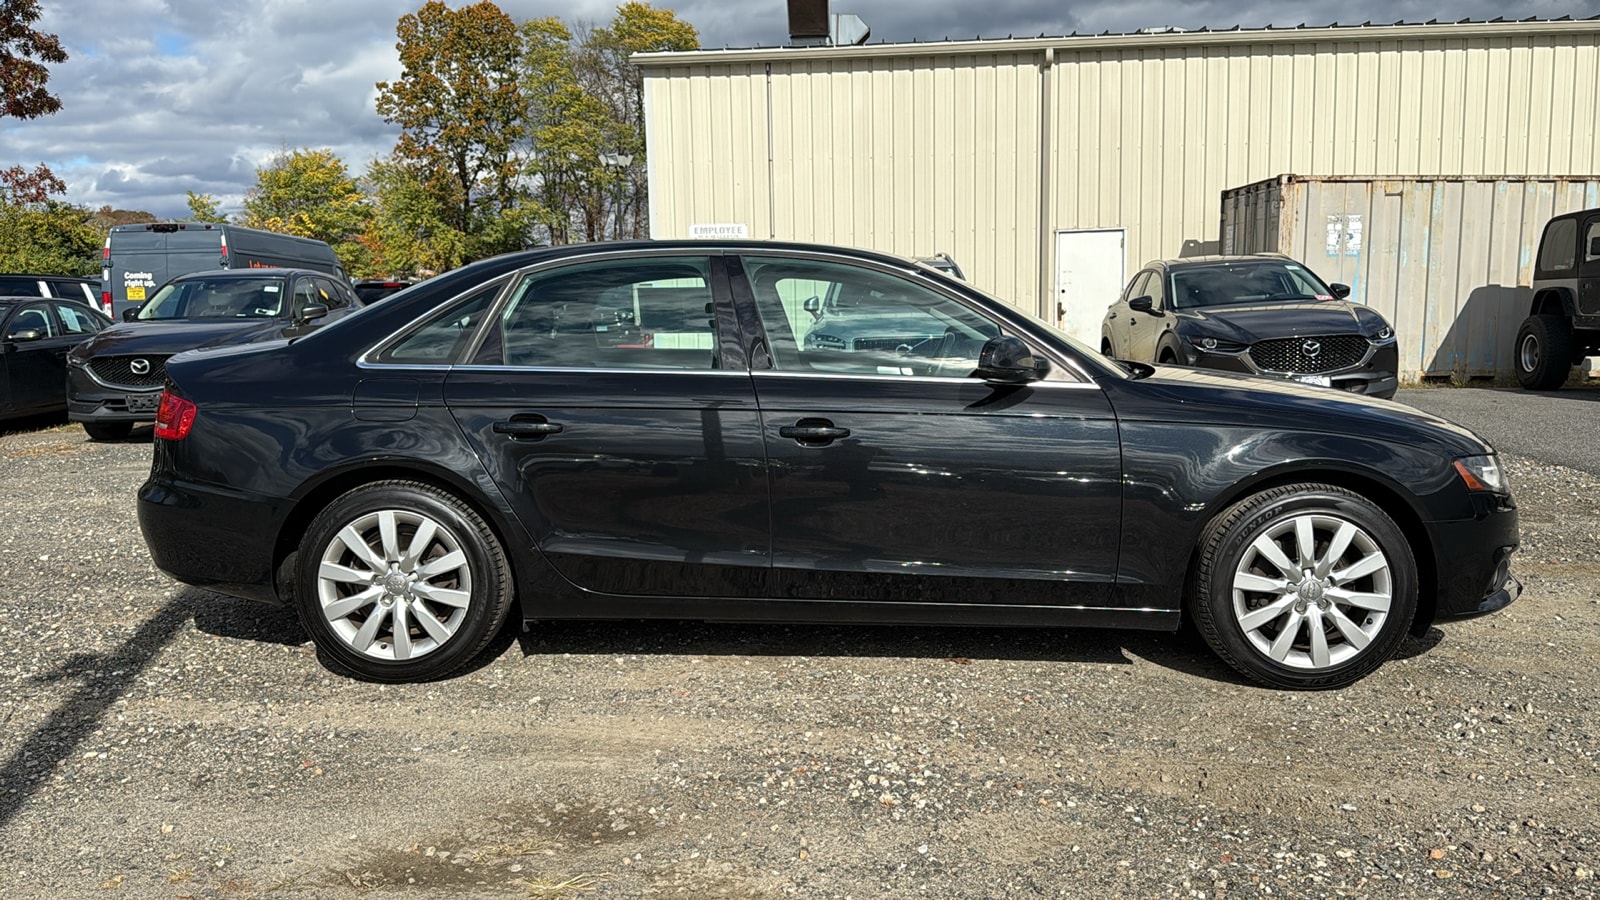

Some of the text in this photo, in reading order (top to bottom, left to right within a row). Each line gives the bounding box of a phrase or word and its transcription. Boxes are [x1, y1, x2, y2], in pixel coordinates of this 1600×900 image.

[694, 226, 743, 235] EMPLOYEE
[124, 271, 153, 280] Coming
[124, 280, 156, 288] right up.
[1235, 505, 1283, 545] DUNLOP
